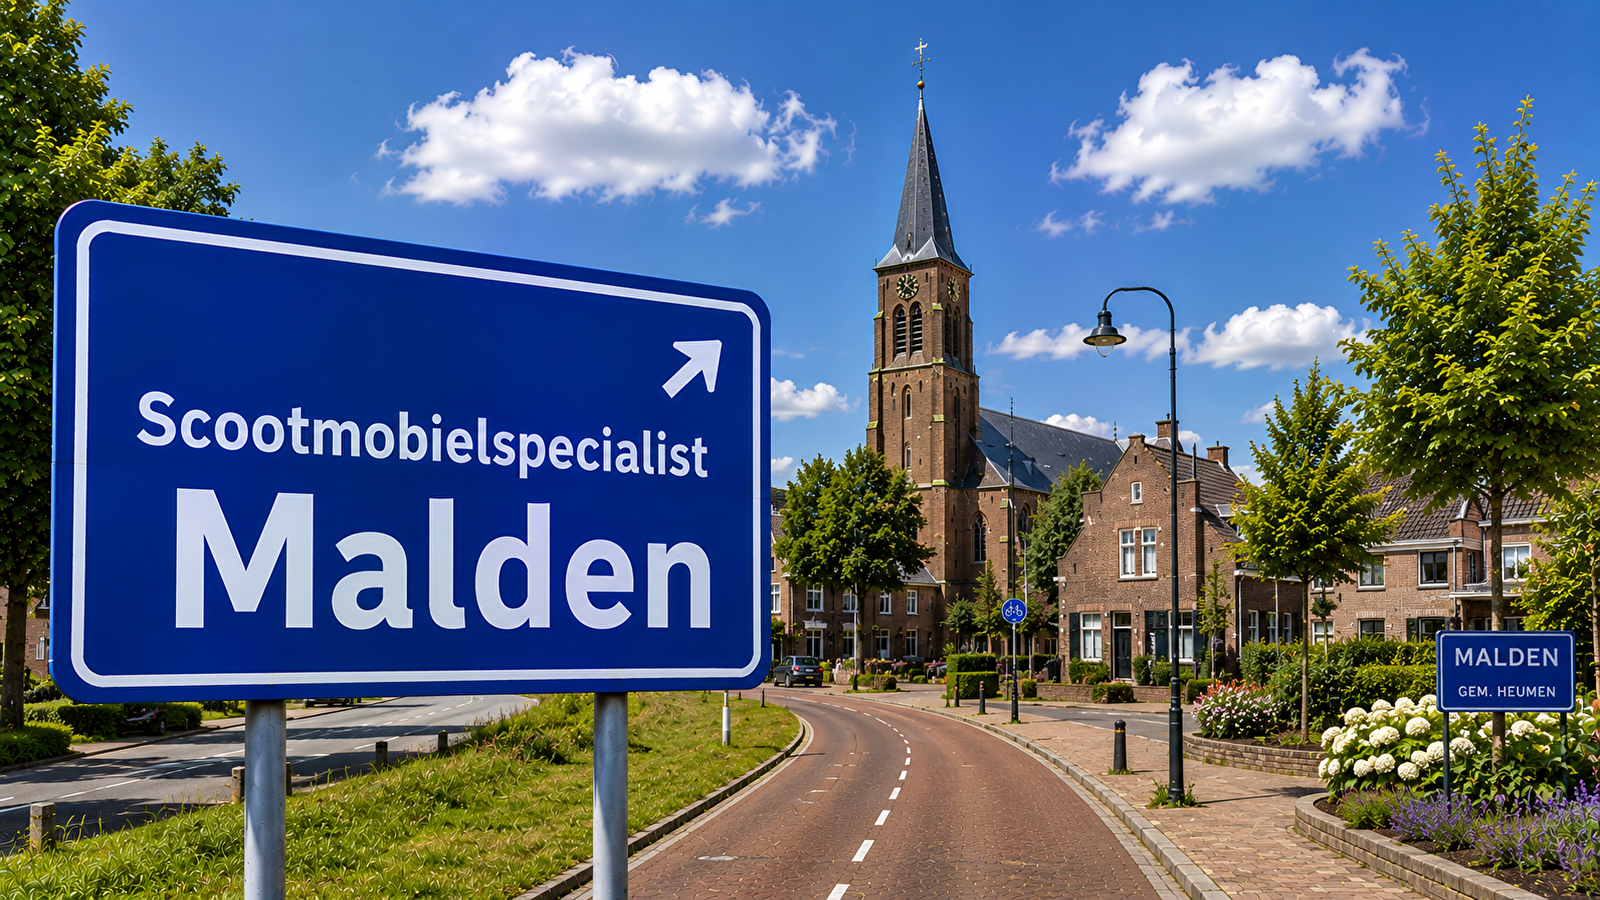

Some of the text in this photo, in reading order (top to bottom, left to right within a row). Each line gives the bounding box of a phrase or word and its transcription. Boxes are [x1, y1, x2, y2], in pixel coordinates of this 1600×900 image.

[136, 391, 709, 479] Scootmobielspecialist
[175, 488, 712, 630] Malden
[1455, 647, 1558, 667] MALDEN
[1458, 686, 1556, 697] GEM. HEUMEN
